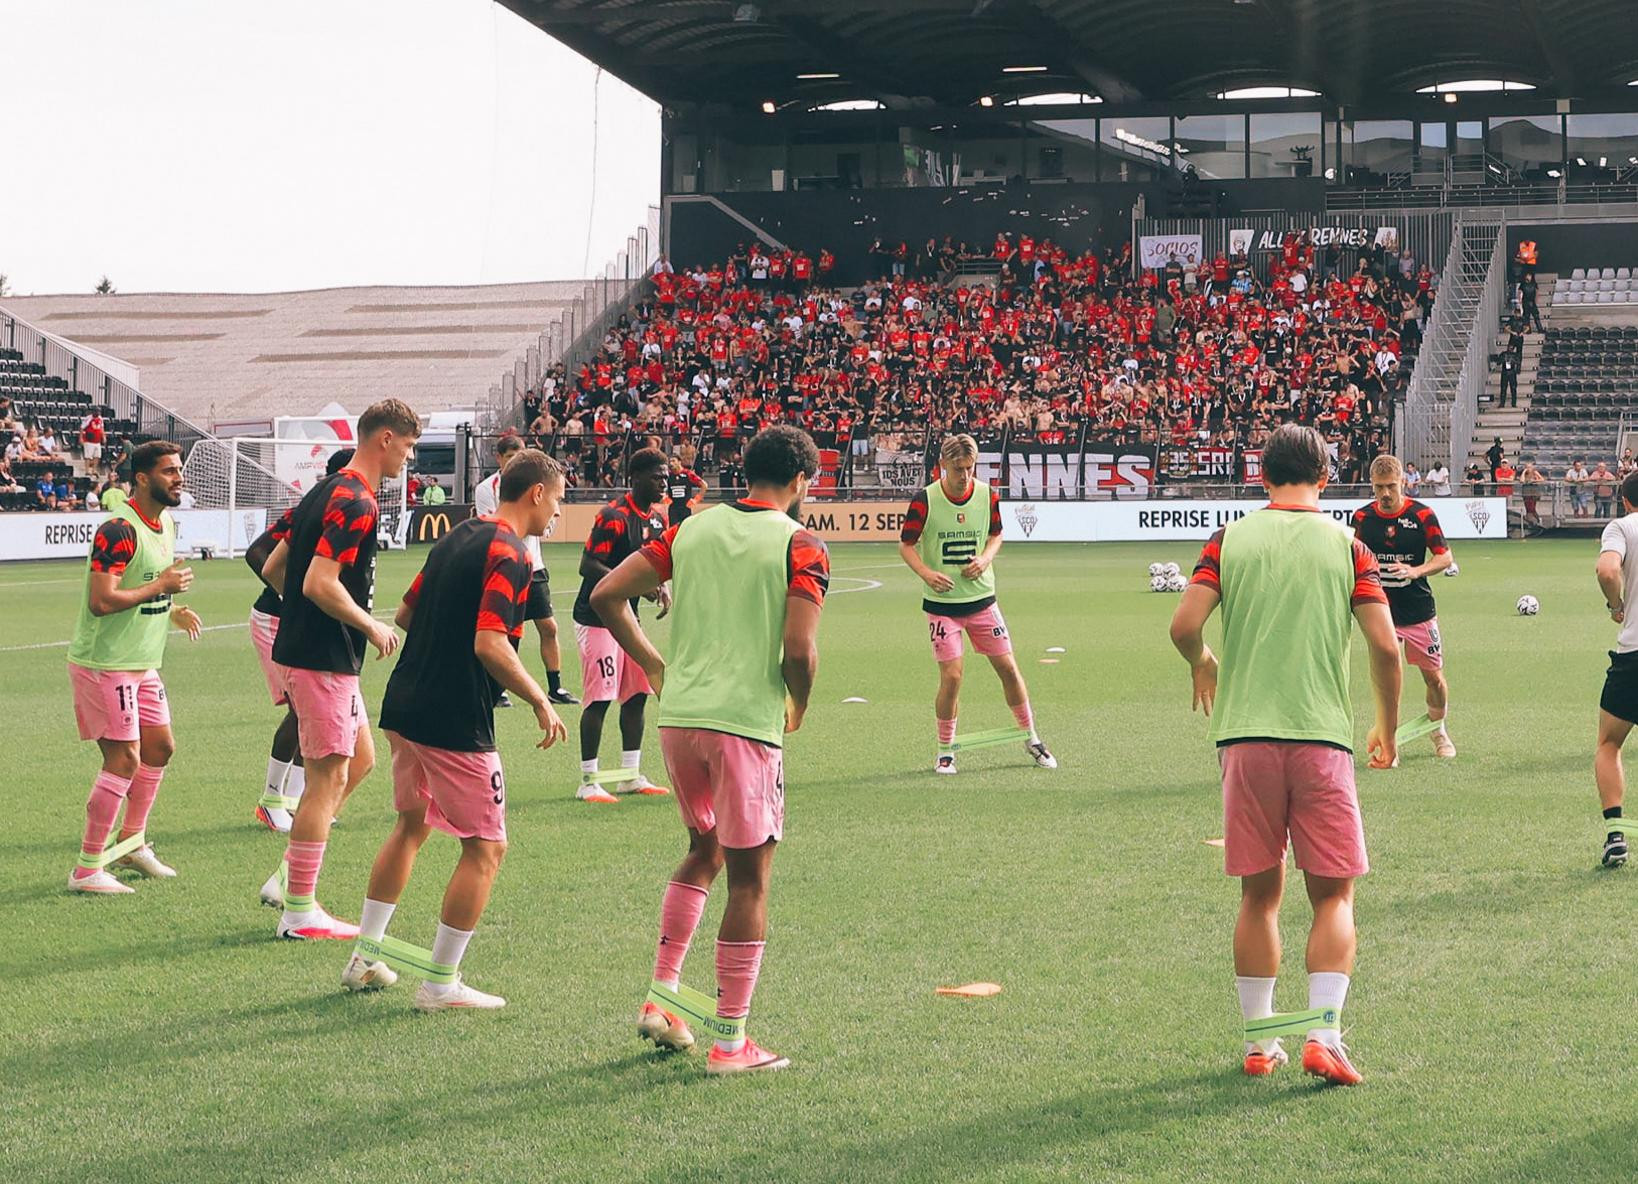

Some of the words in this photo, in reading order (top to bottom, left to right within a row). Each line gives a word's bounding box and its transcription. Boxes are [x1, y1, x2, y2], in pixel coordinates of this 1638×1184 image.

[974, 453, 1151, 500] ENNES
[849, 513, 870, 531] 12
[876, 513, 905, 531] SEP
[1139, 510, 1210, 528] REPRISE
[45, 524, 93, 544] REPRISE
[1372, 553, 1415, 561] AMSIC
[929, 620, 947, 641] 24
[596, 655, 615, 679] 18
[115, 684, 134, 711] 11
[490, 770, 503, 805] 9
[702, 1015, 739, 1036] MEDIUM
